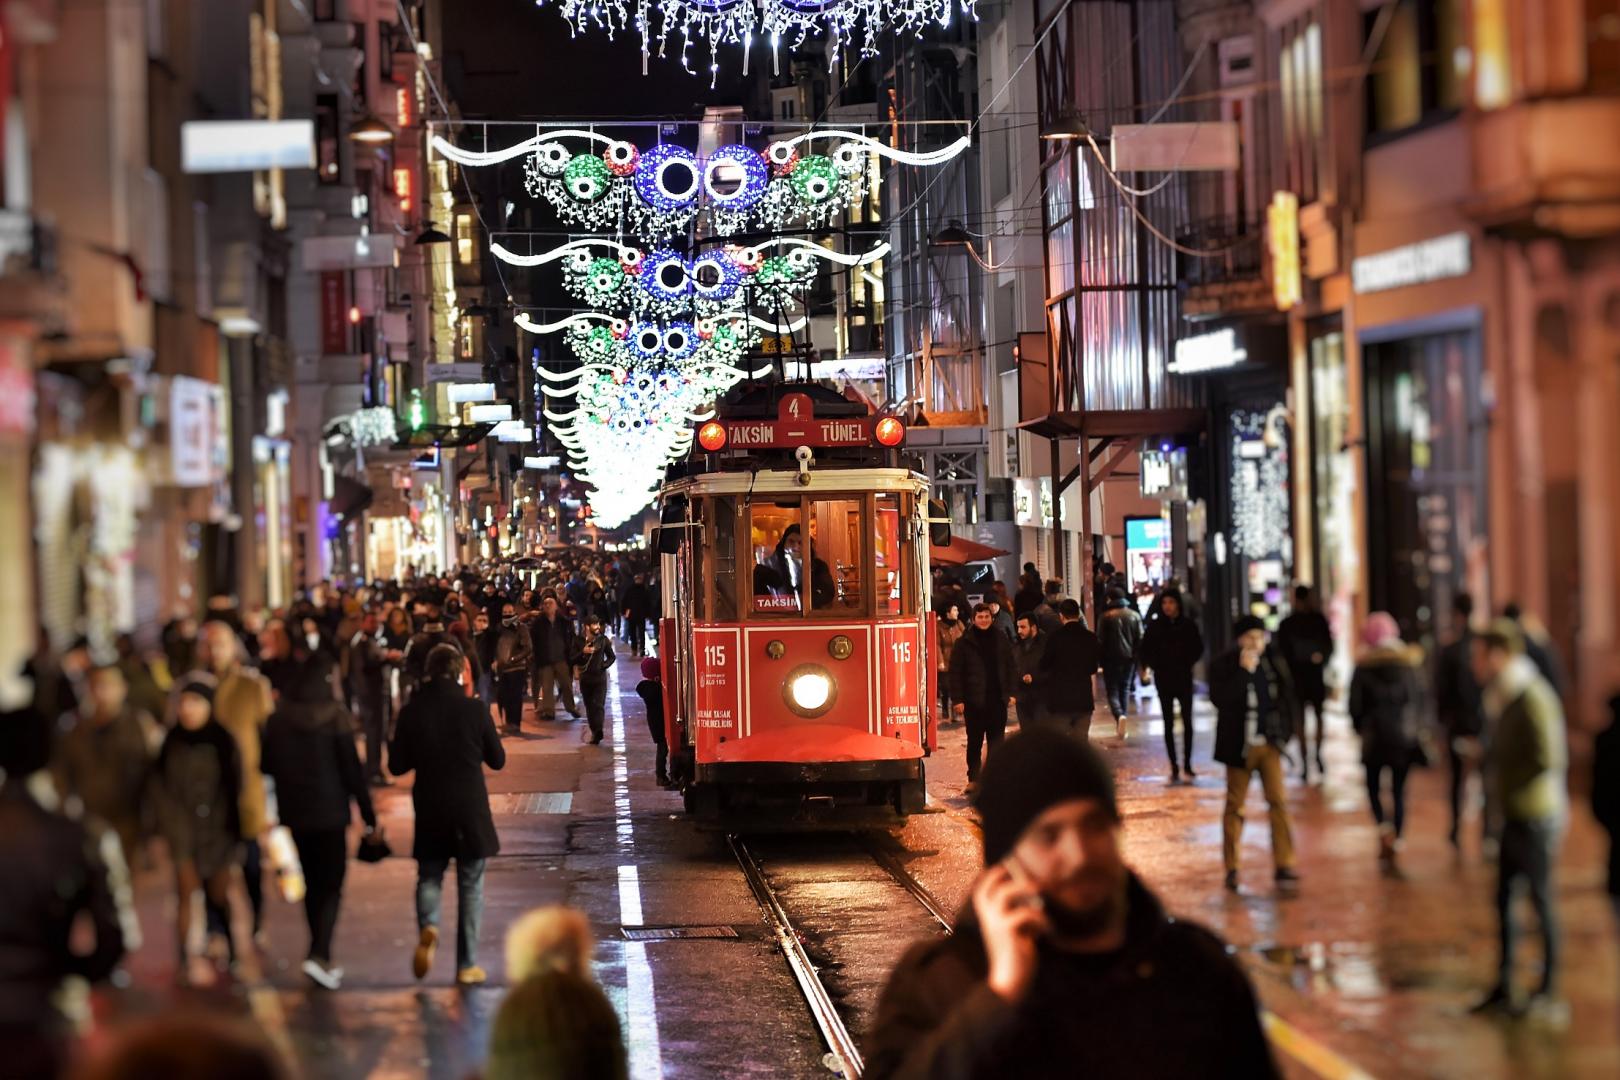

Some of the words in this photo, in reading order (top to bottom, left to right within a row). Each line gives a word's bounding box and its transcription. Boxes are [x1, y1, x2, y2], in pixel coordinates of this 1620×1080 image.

[789, 398, 799, 419] 4
[820, 421, 867, 442] TÜNEL
[704, 645, 726, 666] 115
[891, 641, 911, 663] 115
